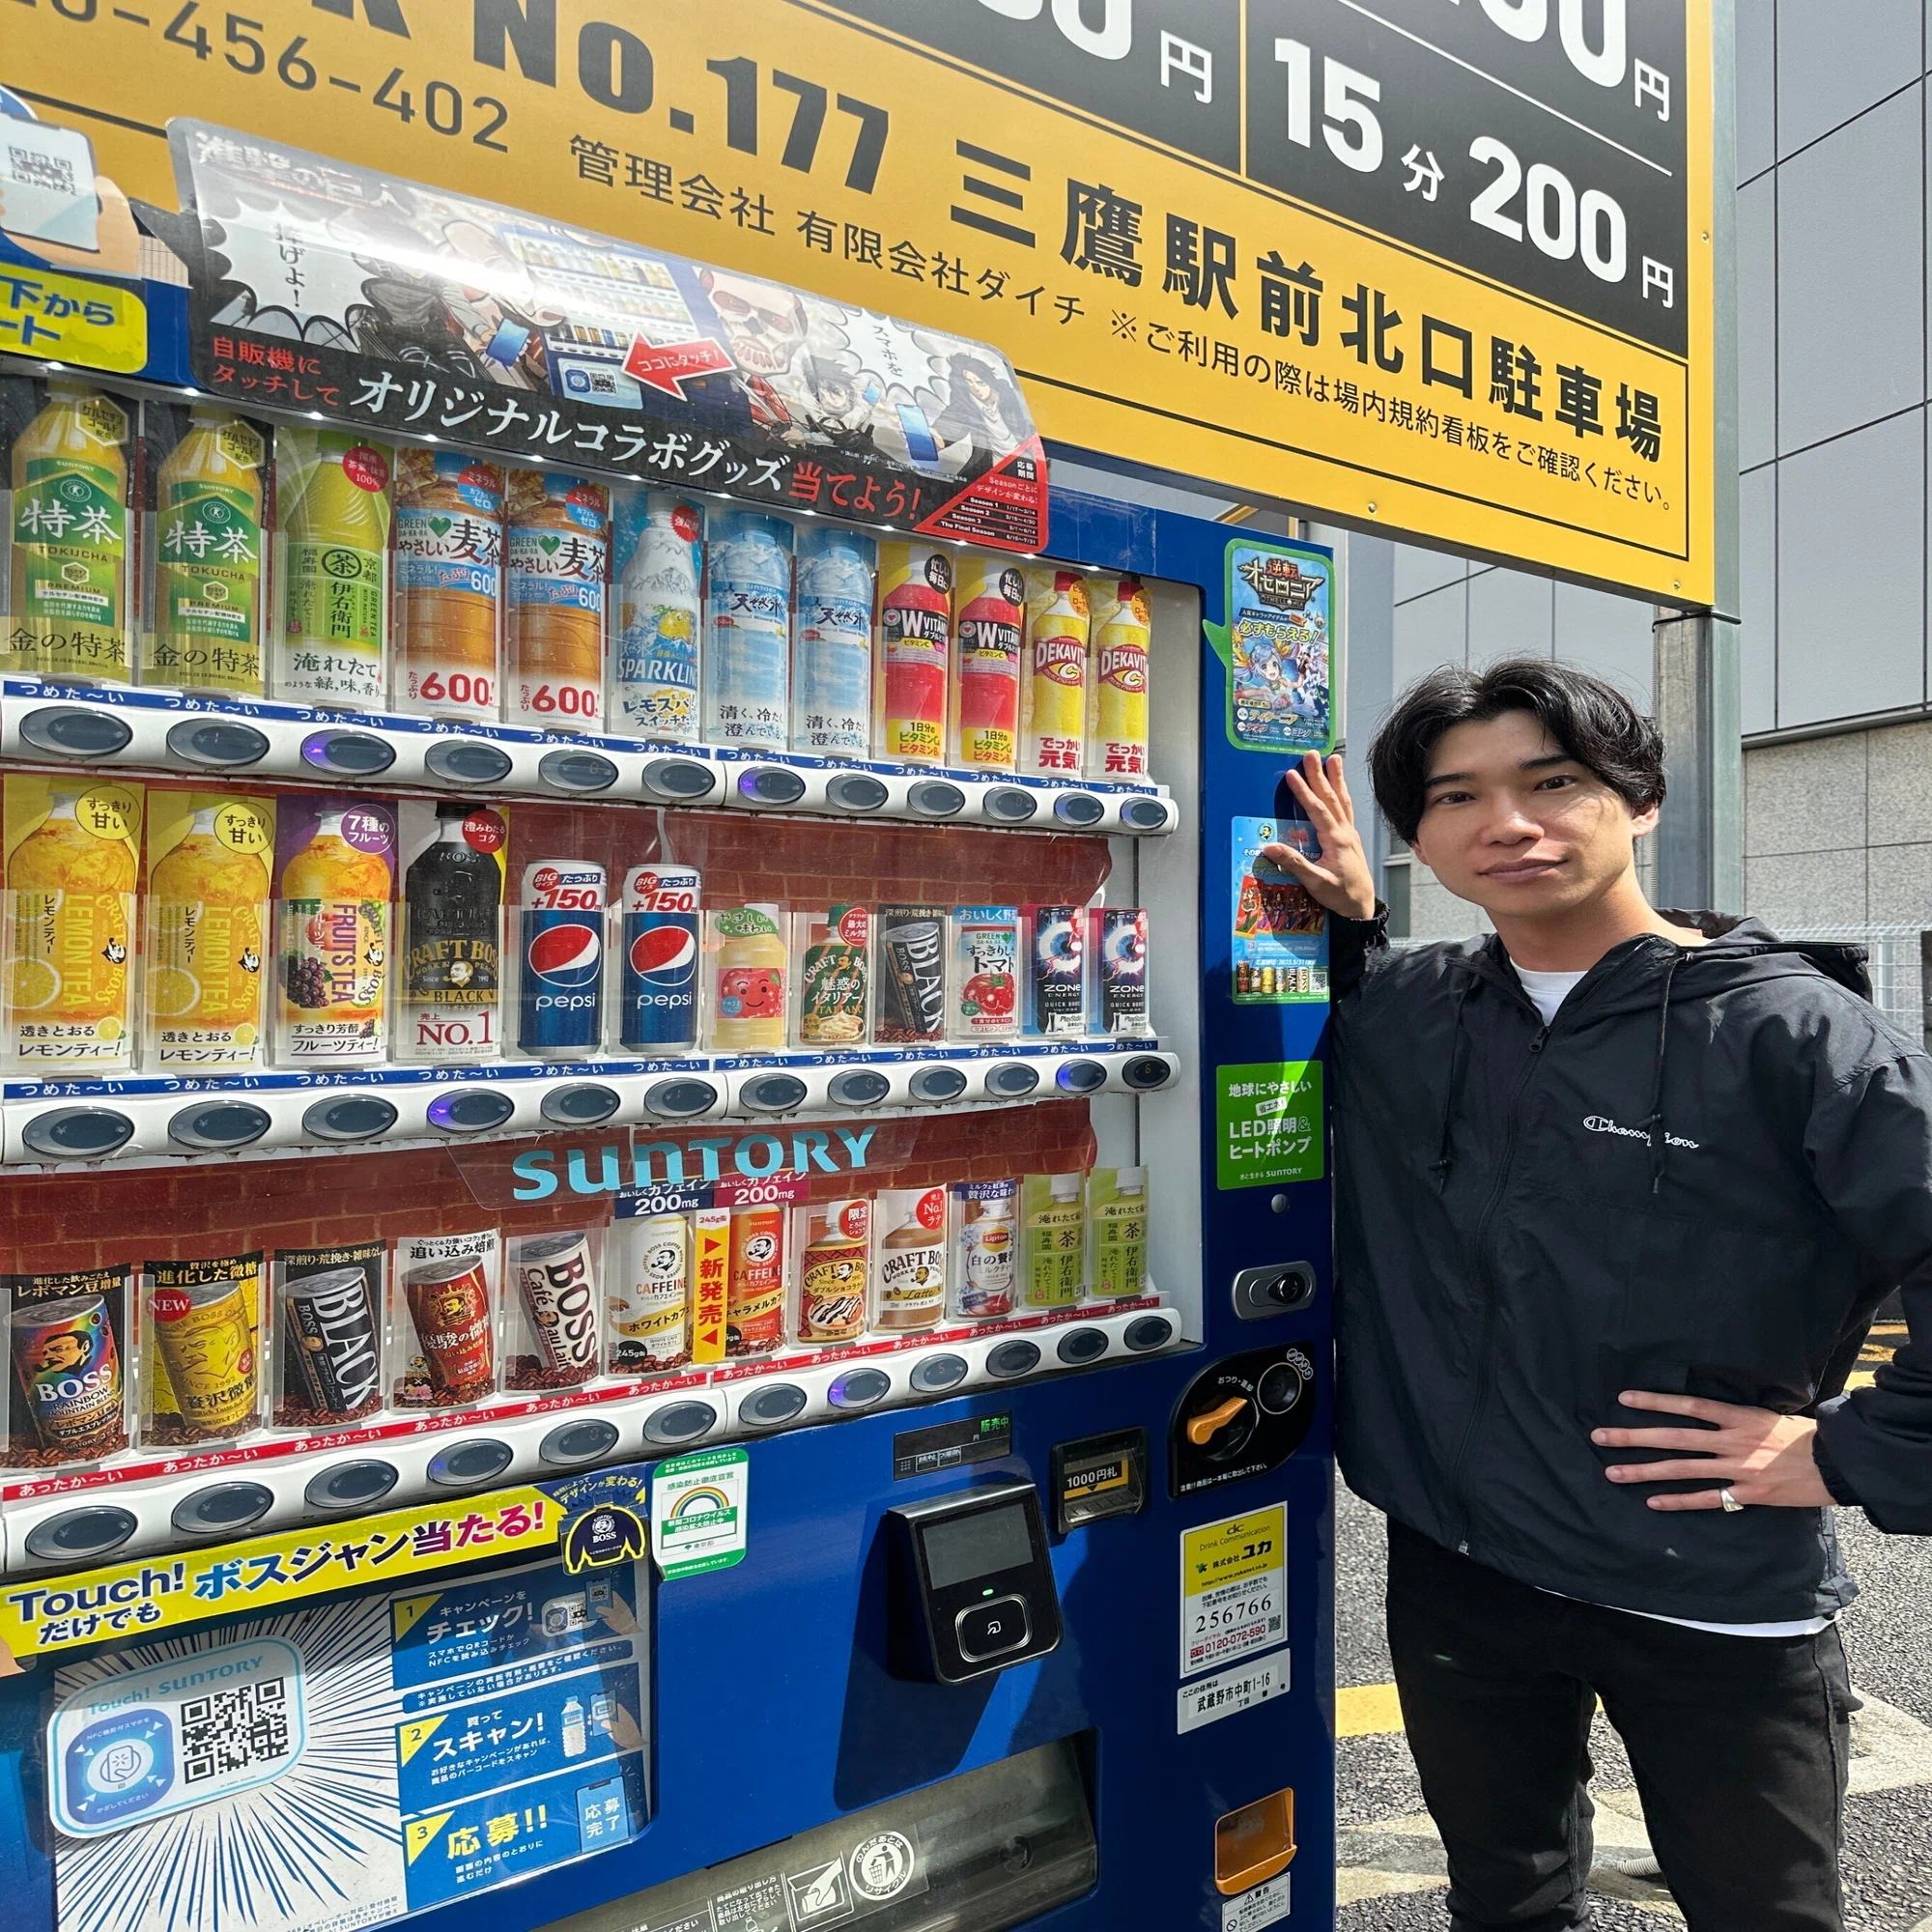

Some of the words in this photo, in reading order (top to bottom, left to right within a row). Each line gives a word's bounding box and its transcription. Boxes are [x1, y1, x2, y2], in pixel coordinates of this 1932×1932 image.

[473, 0, 890, 194] No.177
[950, 138, 1662, 463] 三鷹駅前北口駐車場
[570, 133, 777, 237] 管理会社
[797, 208, 1085, 325] 有限会社ダイチ
[213, 336, 322, 377] 自販機に
[213, 363, 340, 408] タッチして
[960, 504, 985, 515] Season
[970, 497, 993, 507] Season
[18, 497, 123, 546] 特茶
[398, 518, 427, 530] GREEN
[952, 513, 976, 524] Season
[162, 520, 258, 564] 特茶
[509, 536, 538, 549] GREEN
[972, 526, 995, 537] Season
[39, 545, 108, 563] TOKUCHA
[329, 554, 357, 576] 茶
[182, 564, 246, 582] TOKUCHA
[1265, 557, 1298, 578] 逆転
[47, 582, 101, 595] PREMIUM
[329, 582, 354, 639] 伊右衛門
[729, 592, 784, 618] 天然水
[815, 606, 867, 631] 天然水
[9, 627, 126, 664] 金の特茶
[153, 643, 261, 678] 金の特茶
[294, 652, 378, 678] 淹れたて
[87, 797, 132, 813] すっきり
[91, 812, 128, 830] 甘い
[224, 814, 266, 828] すっきり
[347, 813, 390, 834] 7種の
[464, 821, 506, 835] 澄みわたる
[229, 827, 263, 844] 甘い
[348, 832, 389, 845] フルーツ
[478, 834, 497, 843] コク
[561, 873, 598, 885] たっぷり
[661, 876, 695, 888] たっぷり
[63, 894, 94, 966] LEMON
[202, 906, 232, 975] LEMON
[331, 904, 357, 967] FRUITS
[63, 967, 94, 1007] TEA
[202, 976, 232, 1014] TEA
[331, 969, 357, 1004] TEA
[906, 935, 944, 1033] BLACK
[434, 990, 484, 1003] BLACK
[535, 991, 596, 1011] pepsi
[637, 991, 693, 1009] pepsi
[19, 1024, 96, 1038] 透きとおる
[160, 1031, 233, 1043] 透きとおる
[294, 1023, 360, 1035] すっきり芳醇
[416, 1011, 495, 1046] NO.1
[18, 1040, 121, 1057] レモンティー!
[159, 1045, 256, 1063] レモンティー!
[292, 1037, 380, 1053] フルーツティー!
[1228, 1080, 1313, 1097] 地球にやさしい
[1229, 1116, 1312, 1139] LED照明&
[1229, 1136, 1312, 1160] ヒートポンプ
[512, 1125, 878, 1200] SUNTORY
[1265, 1167, 1302, 1178] SUNTORY
[634, 1195, 699, 1216] 200mg
[734, 1184, 795, 1206] 200mg
[984, 1233, 1009, 1243] Lipton
[1059, 1230, 1076, 1247] 茶
[1123, 1222, 1141, 1239] 茶
[156, 1260, 259, 1285] 進化した微糖
[883, 1250, 926, 1284] CRAFT
[697, 1258, 724, 1326] 新発売
[148, 1297, 190, 1312] NEW
[546, 1252, 598, 1367] BOSS
[298, 1304, 319, 1335] BOSS
[312, 1281, 380, 1410] BLACK
[36, 1363, 113, 1403] BOSS
[52, 1385, 109, 1409] RAINBOW
[980, 1416, 1009, 1433] 販売中
[1066, 1466, 1118, 1489] 1000円札
[592, 1531, 617, 1544] BOSS
[1220, 1524, 1271, 1546] Communication
[11, 1562, 185, 1624] Touch!
[193, 1501, 544, 1601] ボスジャン当たる!
[1212, 1553, 1240, 1570] 株式会社
[1241, 1539, 1272, 1561] ユカ
[405, 1605, 414, 1618] 1
[440, 1590, 527, 1617] キャンペーンを
[1195, 1593, 1272, 1634] 256766
[39, 1603, 161, 1645] だけでも
[427, 1602, 533, 1645] チェック!
[1205, 1624, 1266, 1653] 0120-072-590
[88, 1687, 151, 1716] Touch!
[158, 1656, 264, 1695] SUNTORY
[1197, 1671, 1271, 1714] 武蔵野市中町1-16
[467, 1709, 503, 1729] 買って
[411, 1727, 423, 1742] 2
[433, 1712, 545, 1762] スキャン!
[584, 1797, 620, 1822] 応募
[416, 1826, 429, 1840] 3
[586, 1815, 621, 1840] 完了
[856, 1835, 904, 1863] のんだあとは
[866, 1870, 907, 1894] リサイクル
